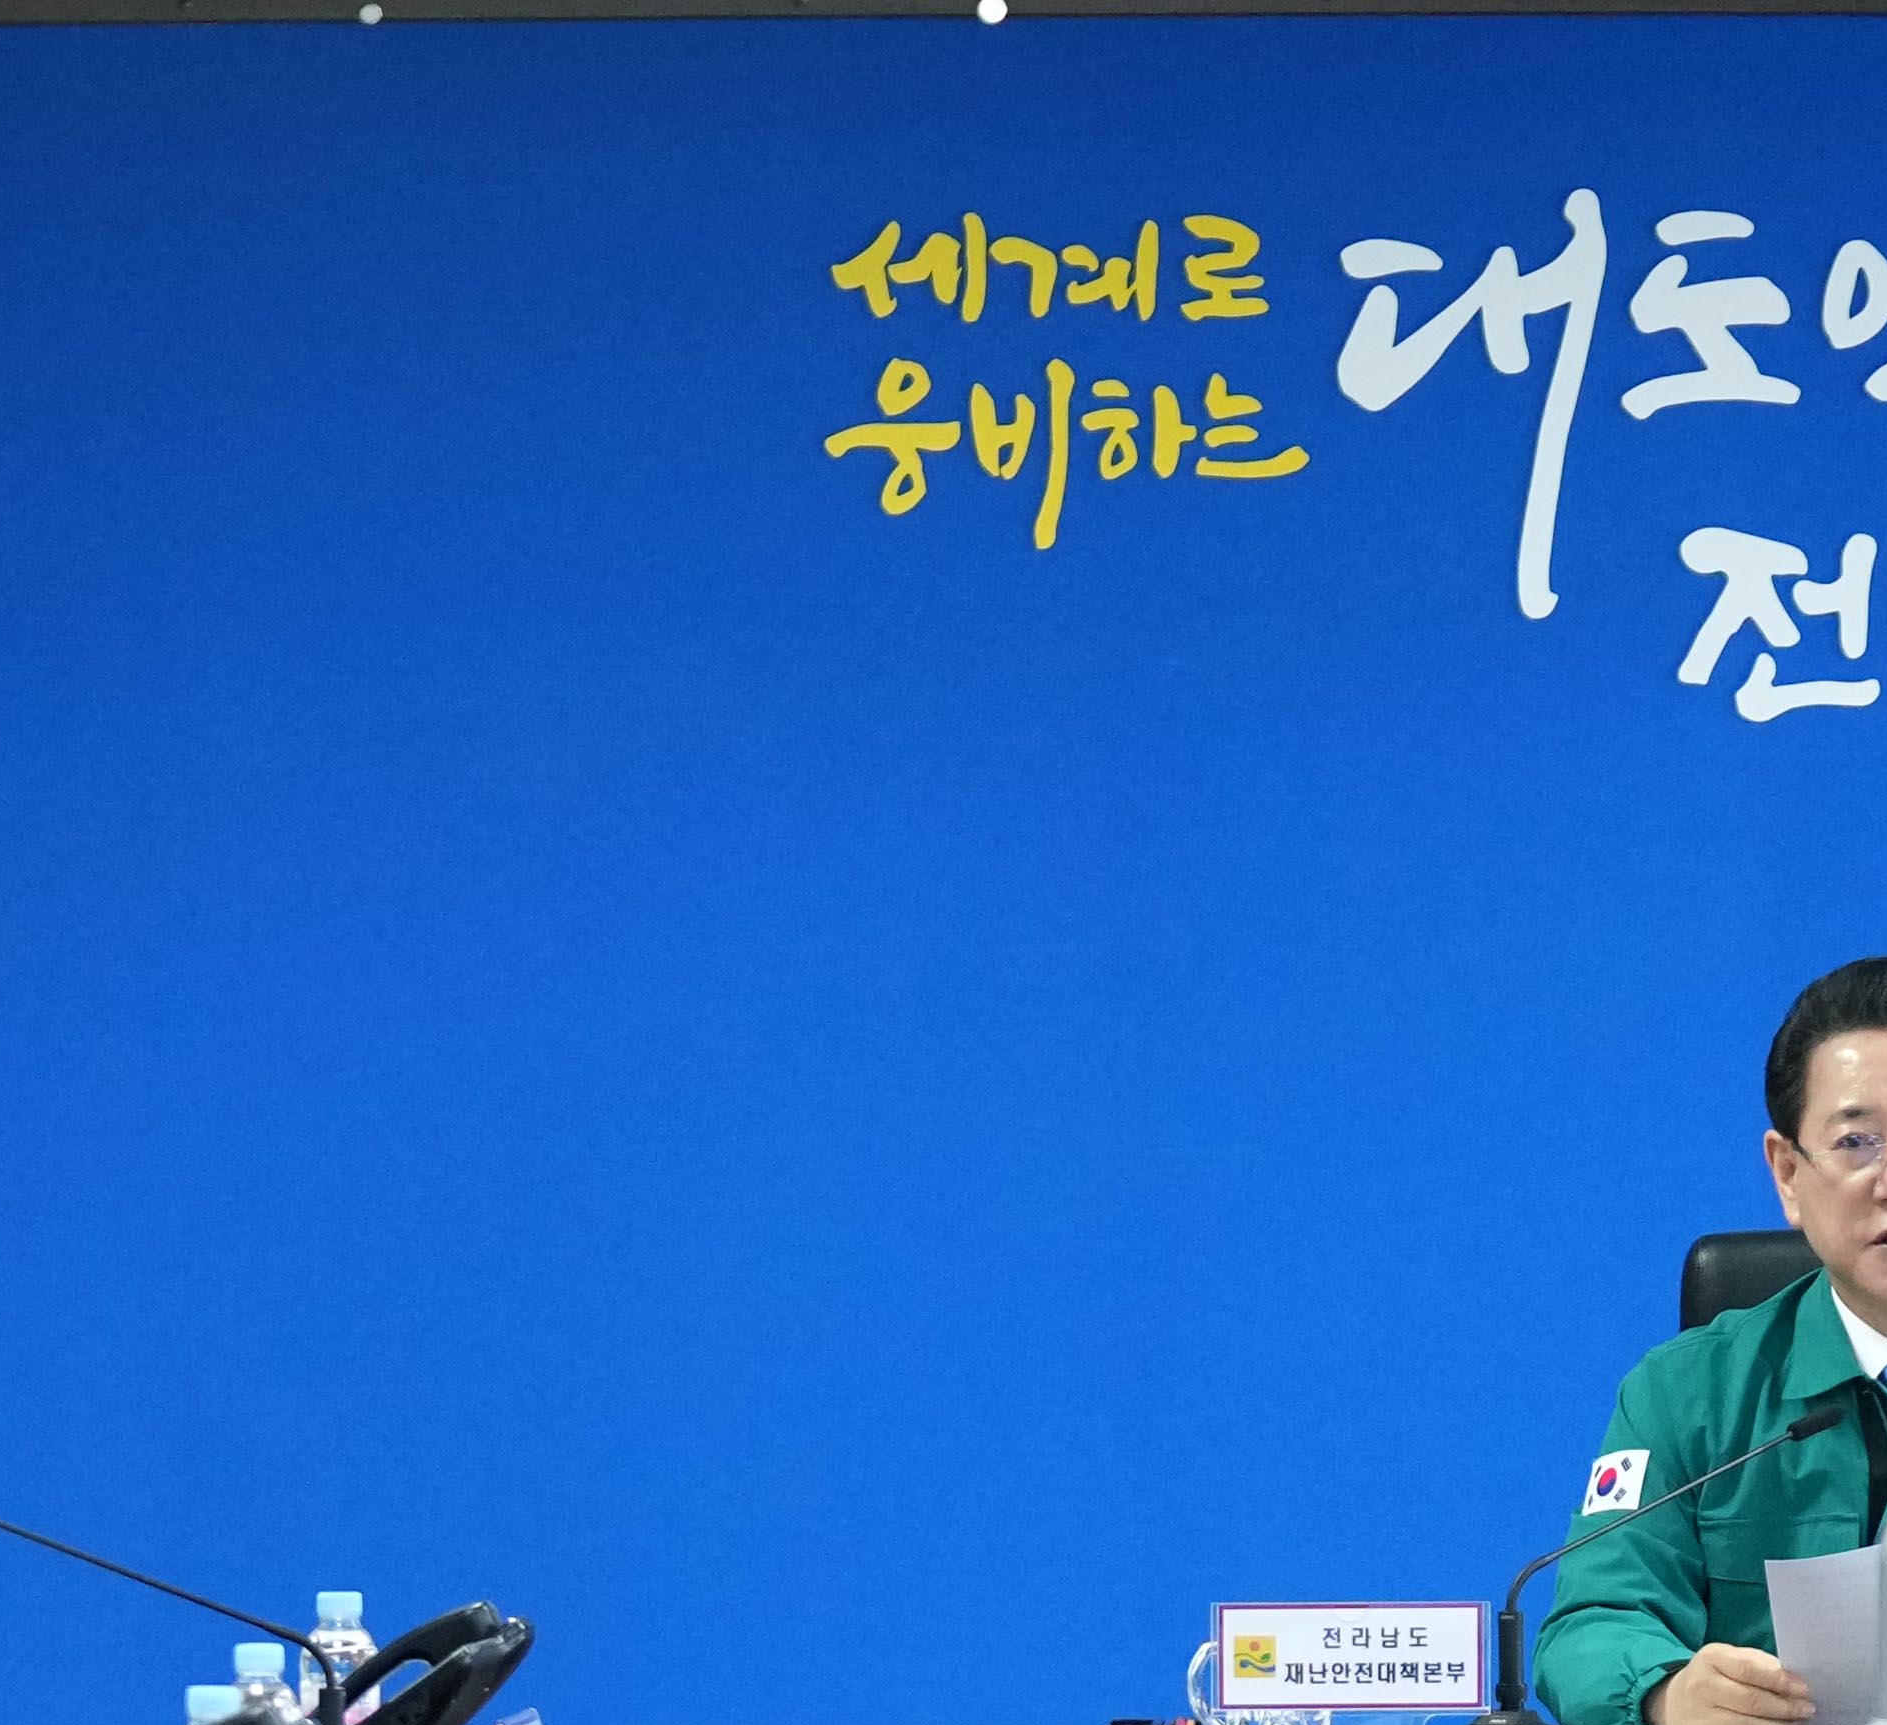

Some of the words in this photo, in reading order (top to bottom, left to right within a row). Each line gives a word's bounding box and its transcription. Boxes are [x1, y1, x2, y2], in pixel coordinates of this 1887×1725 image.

[831, 212, 1269, 323] 세계로
[824, 358, 1310, 550] 웅비하는
[1284, 1661, 1467, 1684] 재난안전대책본부
